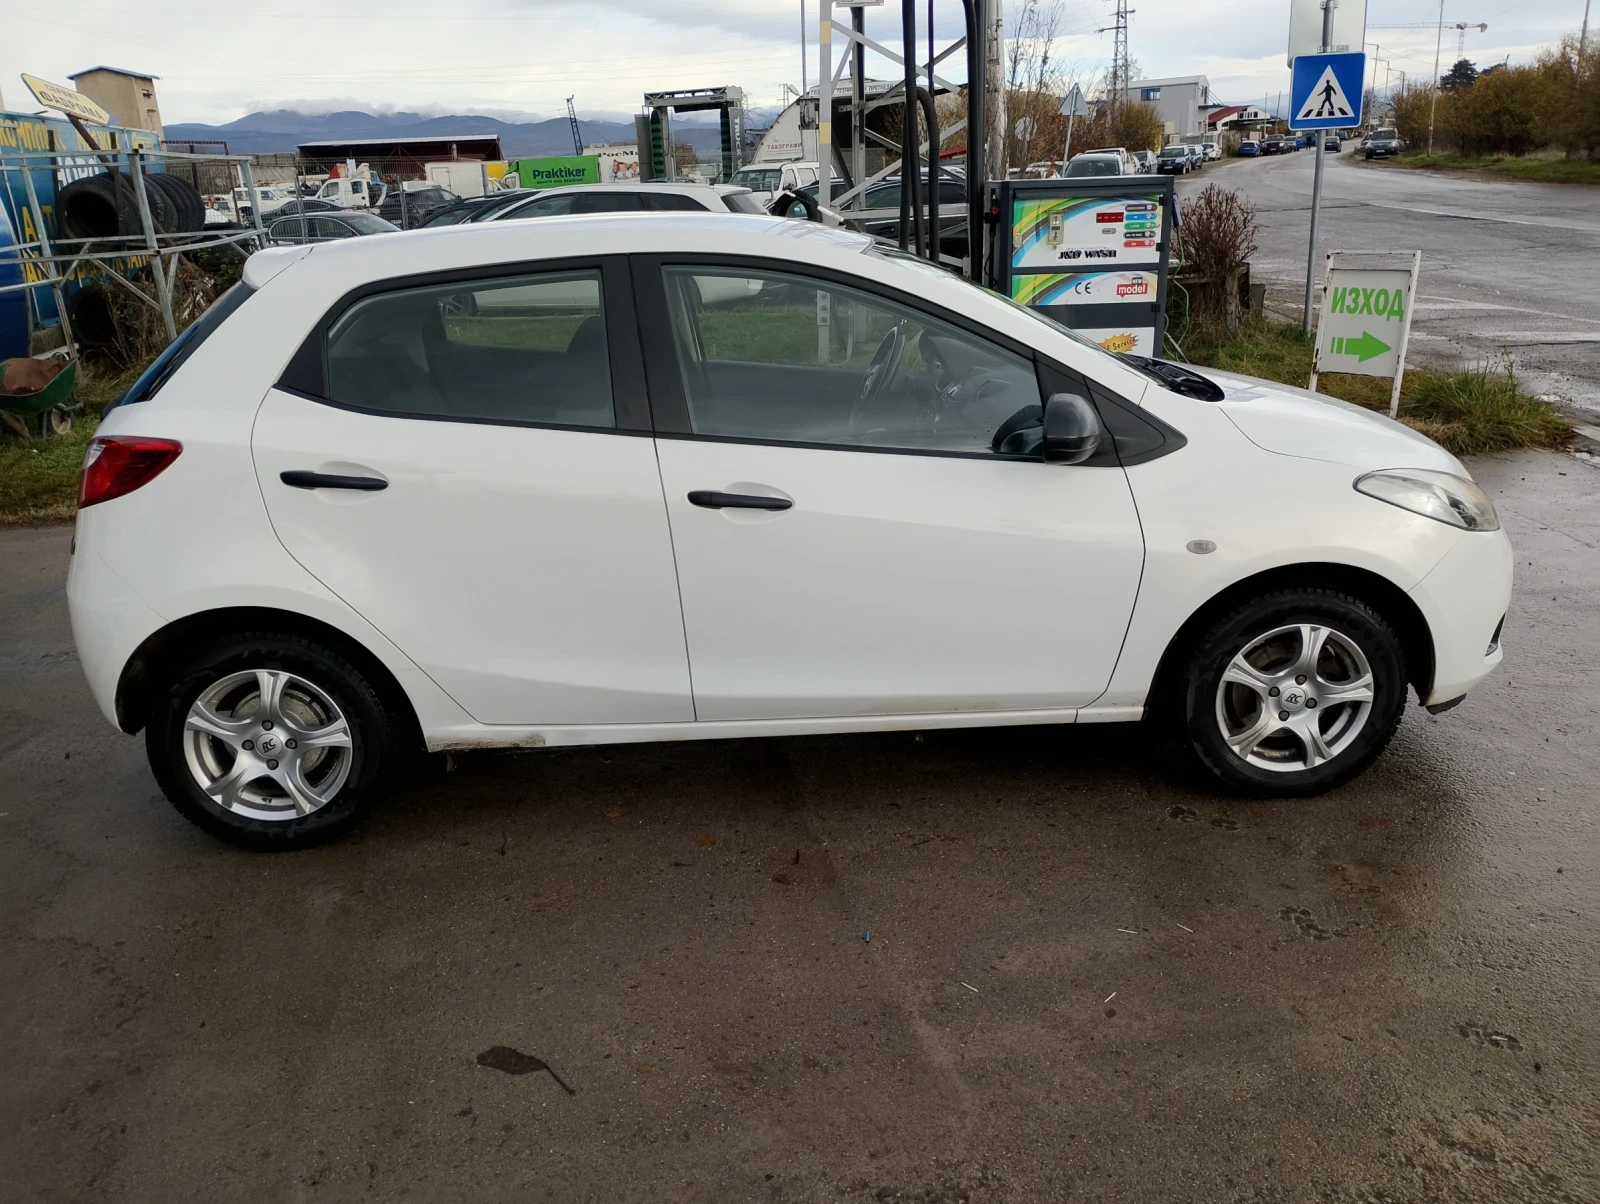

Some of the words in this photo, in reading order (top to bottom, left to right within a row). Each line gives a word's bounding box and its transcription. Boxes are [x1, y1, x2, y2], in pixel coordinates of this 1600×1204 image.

[39, 90, 105, 121] ФАДРОМА
[734, 117, 742, 157] TRUCK
[532, 166, 587, 180] Praktiker
[1058, 250, 1082, 260] J&D
[1084, 249, 1117, 259] WASH
[1118, 284, 1146, 294] model
[1330, 287, 1404, 322] ИЗХОД
